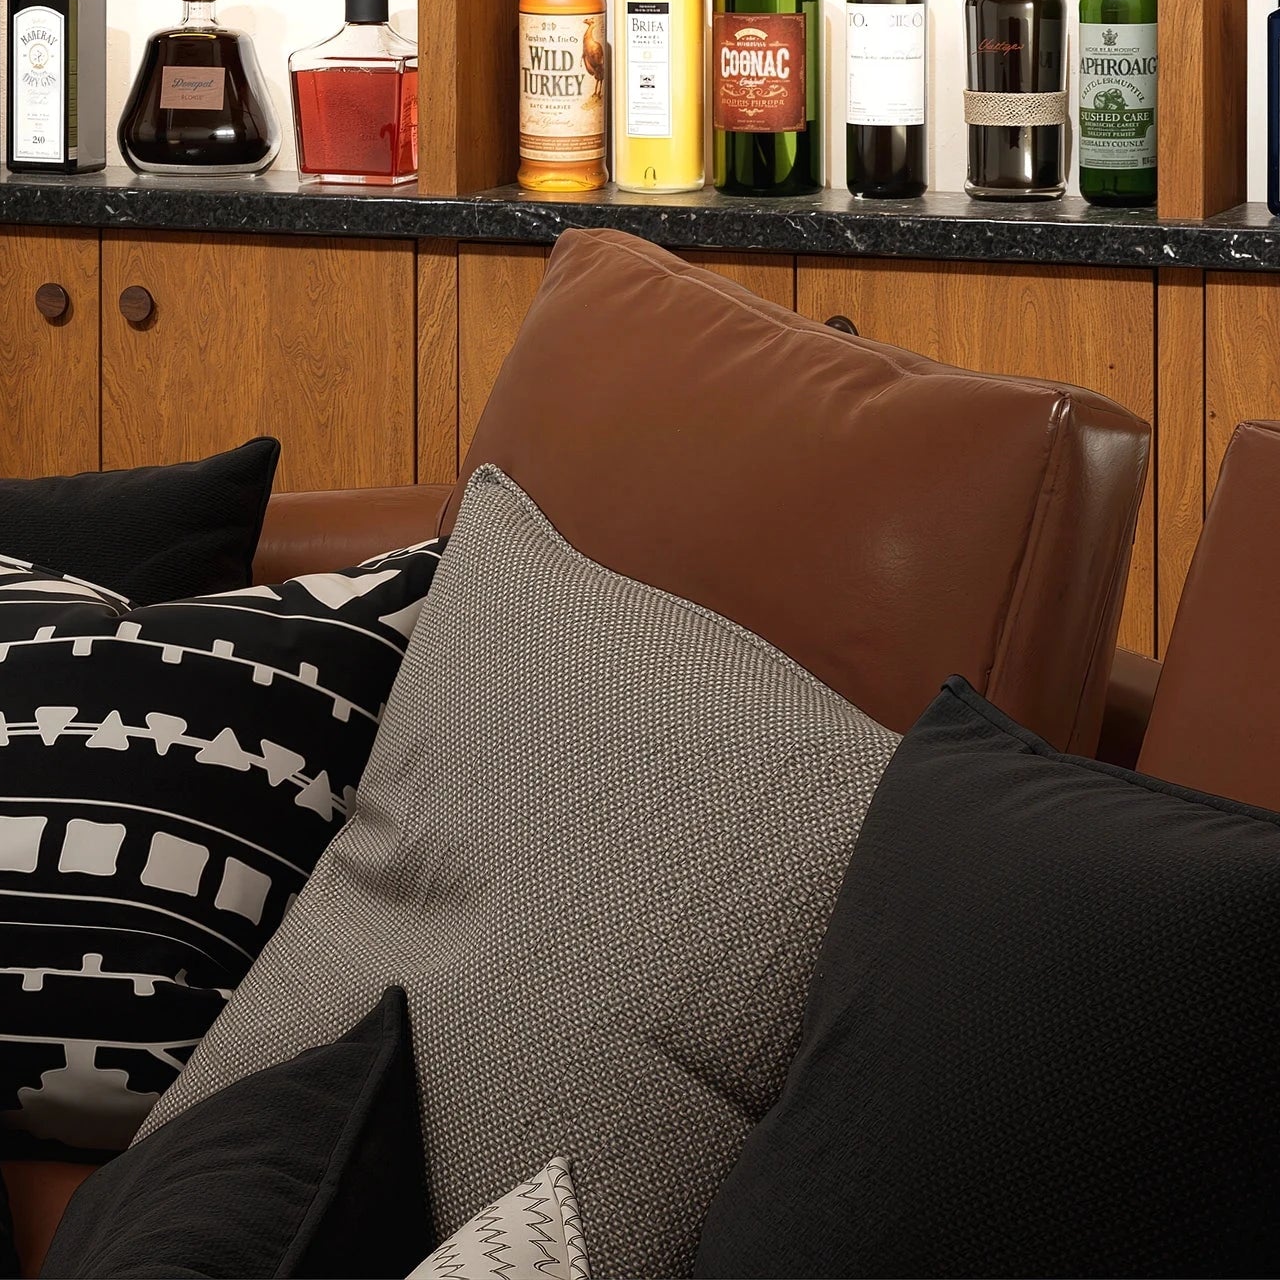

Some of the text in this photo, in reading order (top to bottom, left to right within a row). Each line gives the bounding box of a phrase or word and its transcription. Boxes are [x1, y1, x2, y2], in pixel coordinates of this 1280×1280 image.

[529, 46, 573, 72] WILD
[721, 47, 790, 79] COGNAC
[522, 67, 584, 98] TURKEY
